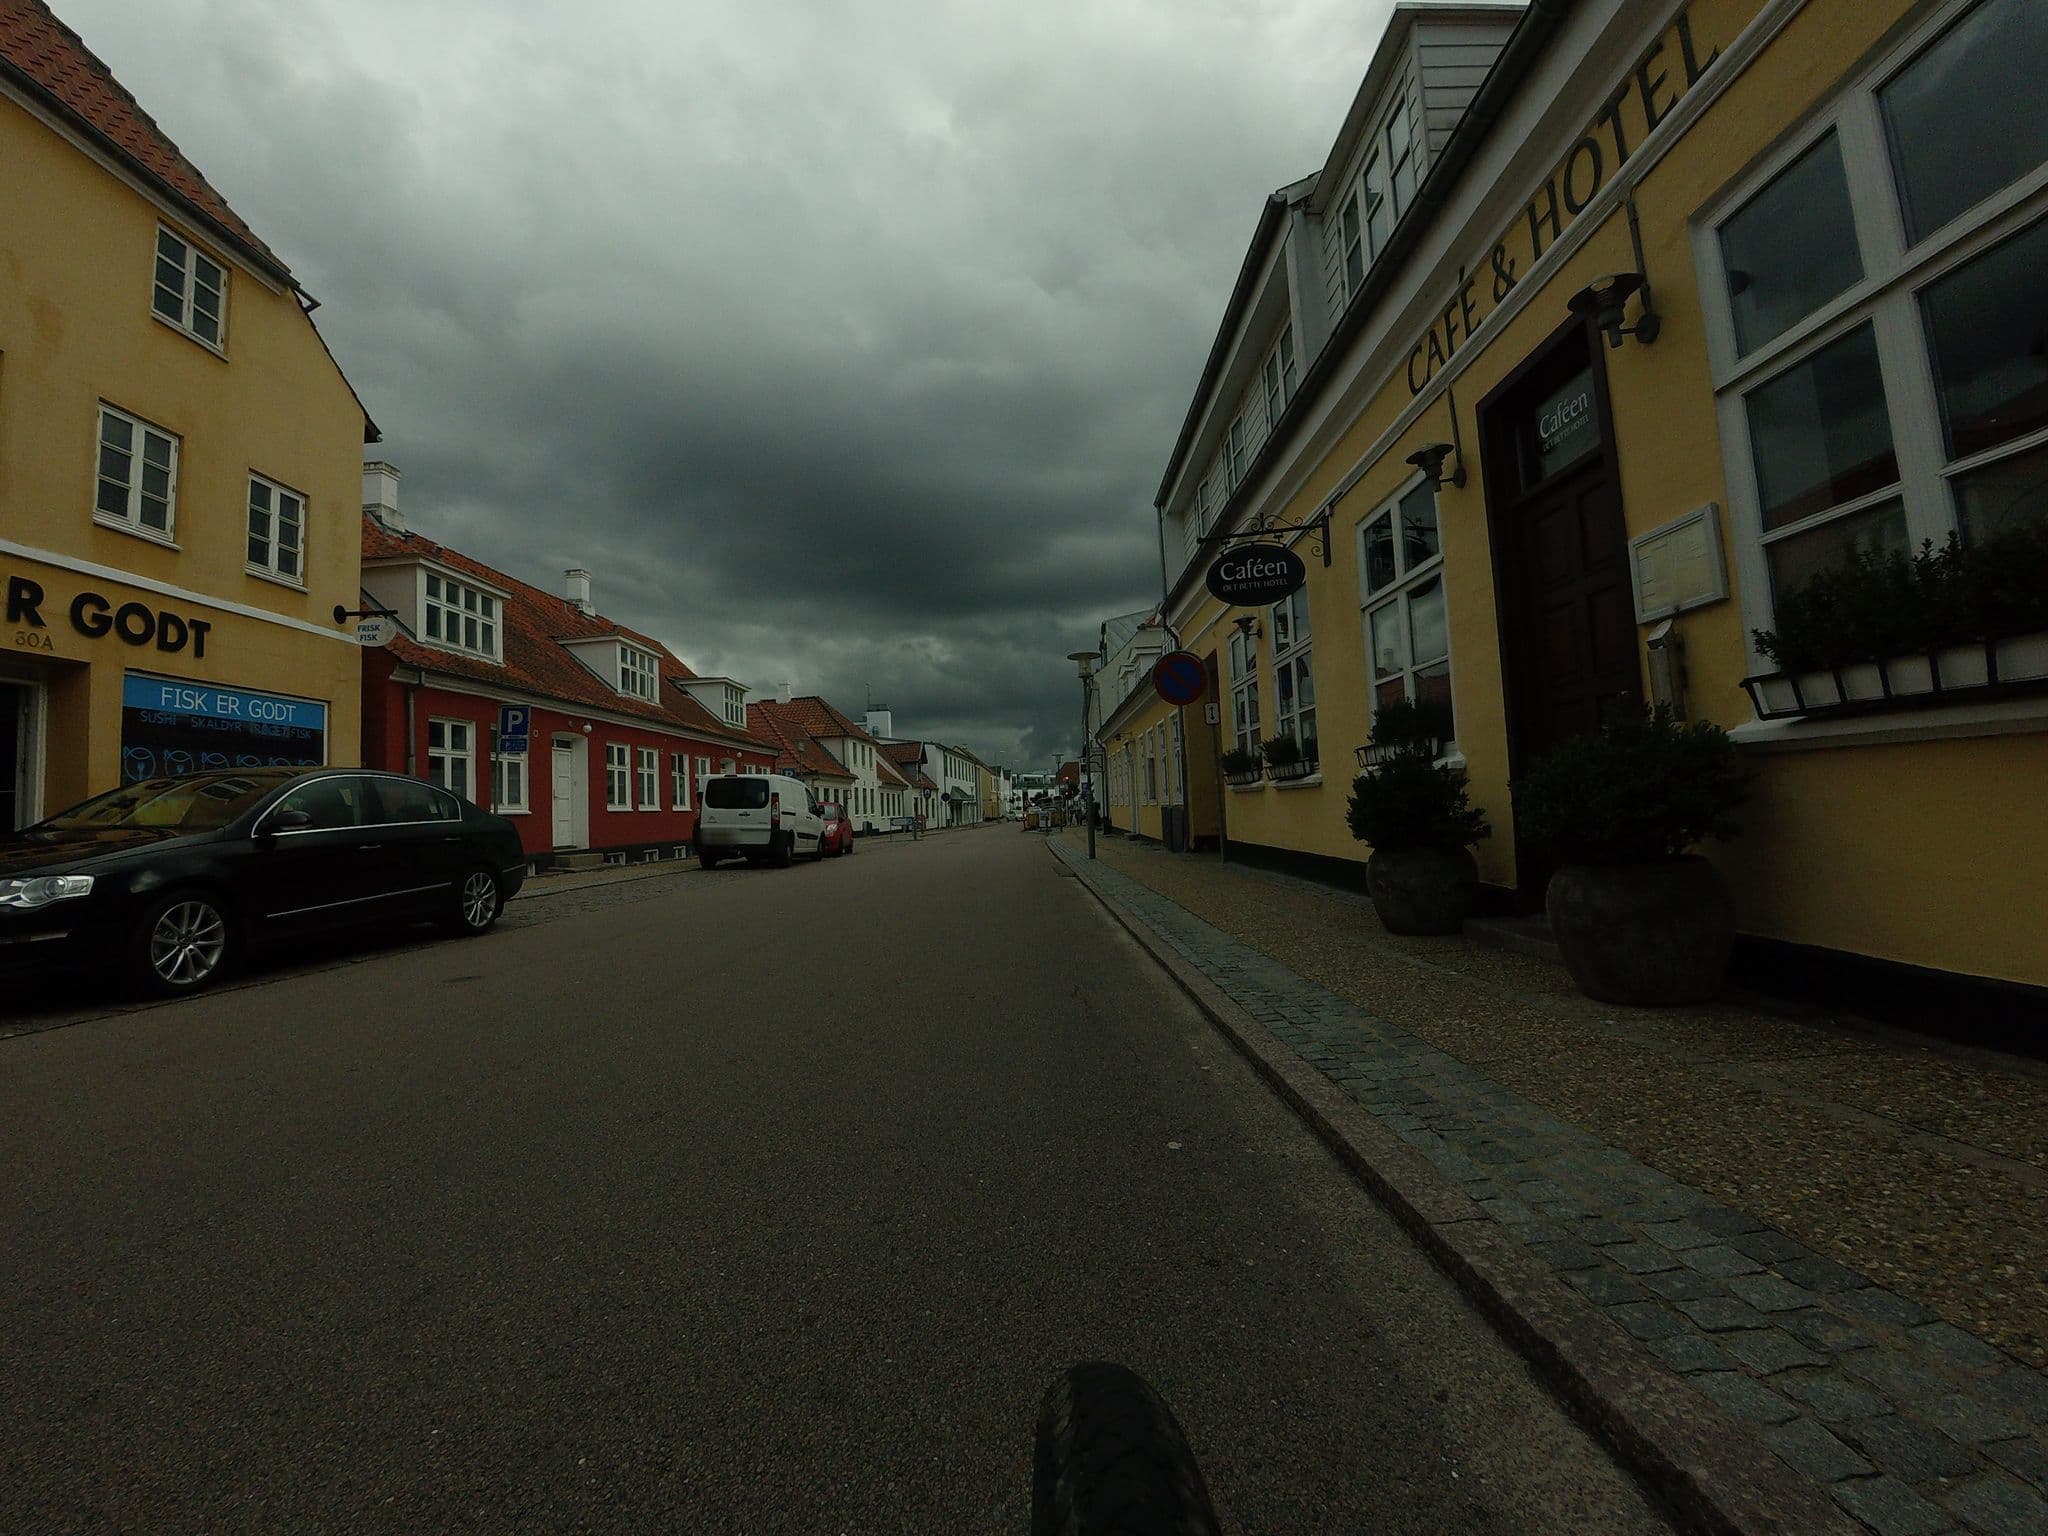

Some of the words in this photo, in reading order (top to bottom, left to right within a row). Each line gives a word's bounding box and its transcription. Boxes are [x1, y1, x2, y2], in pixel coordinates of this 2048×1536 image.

[1407, 266, 1482, 395] CAFÉ
[1491, 243, 1518, 303] &
[1527, 11, 1720, 262] HOTEL
[1540, 393, 1589, 439] Caféen
[1220, 558, 1288, 581] Caféen
[71, 592, 211, 657] GODT
[357, 624, 381, 632] FRISK
[15, 631, 54, 651] 30A
[360, 633, 378, 641] FISK
[160, 686, 208, 712] FISK
[216, 694, 241, 716] ER
[248, 699, 297, 723] GODT
[139, 709, 177, 727] SUSHI
[507, 710, 524, 733] P
